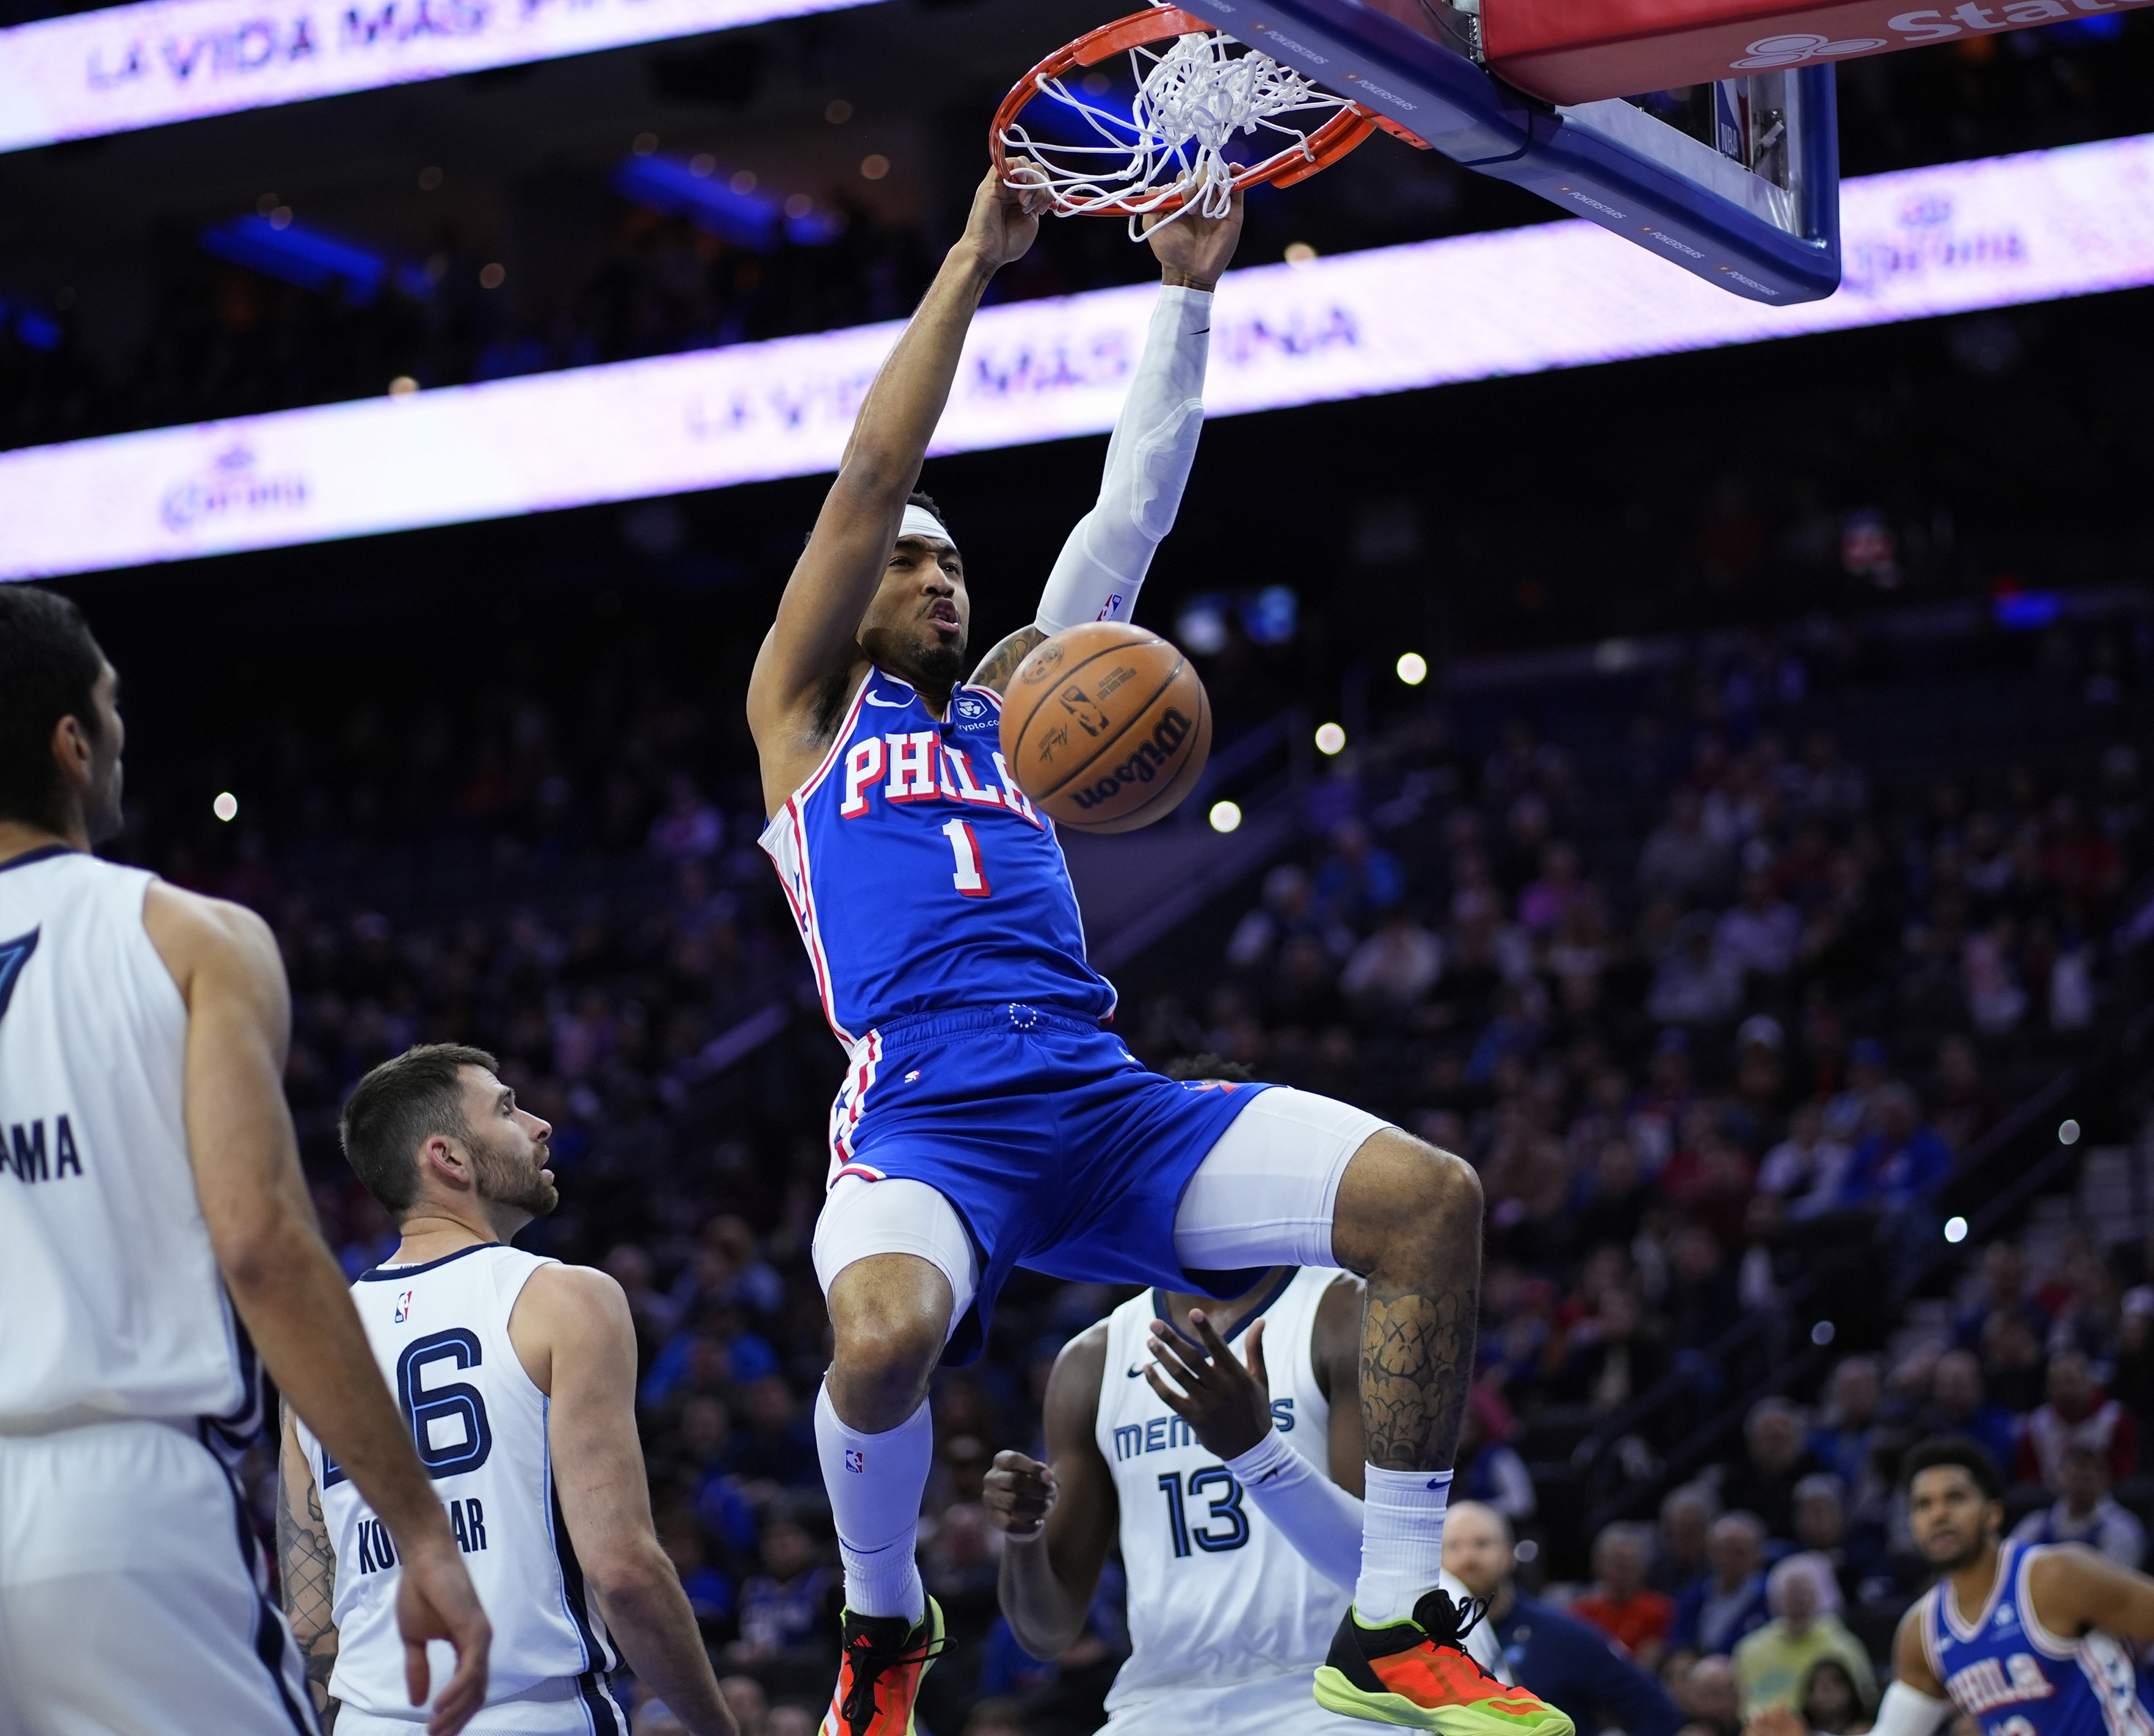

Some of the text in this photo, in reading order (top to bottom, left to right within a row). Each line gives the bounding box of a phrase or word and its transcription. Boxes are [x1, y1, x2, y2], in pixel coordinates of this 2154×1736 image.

[1887, 0, 2152, 42] Sta
[1264, 30, 1329, 65] POKERSTARS
[1355, 79, 1417, 111] POKERSTARS
[1568, 191, 1626, 220] POKERSTARS
[1648, 232, 1705, 259] POKERSTARS
[1069, 706, 1192, 809] Wilson
[942, 818, 991, 897] 1
[1113, 1399, 1294, 1462] MEMS
[358, 1498, 487, 1574] KOAR
[1157, 1464, 1249, 1558] 13
